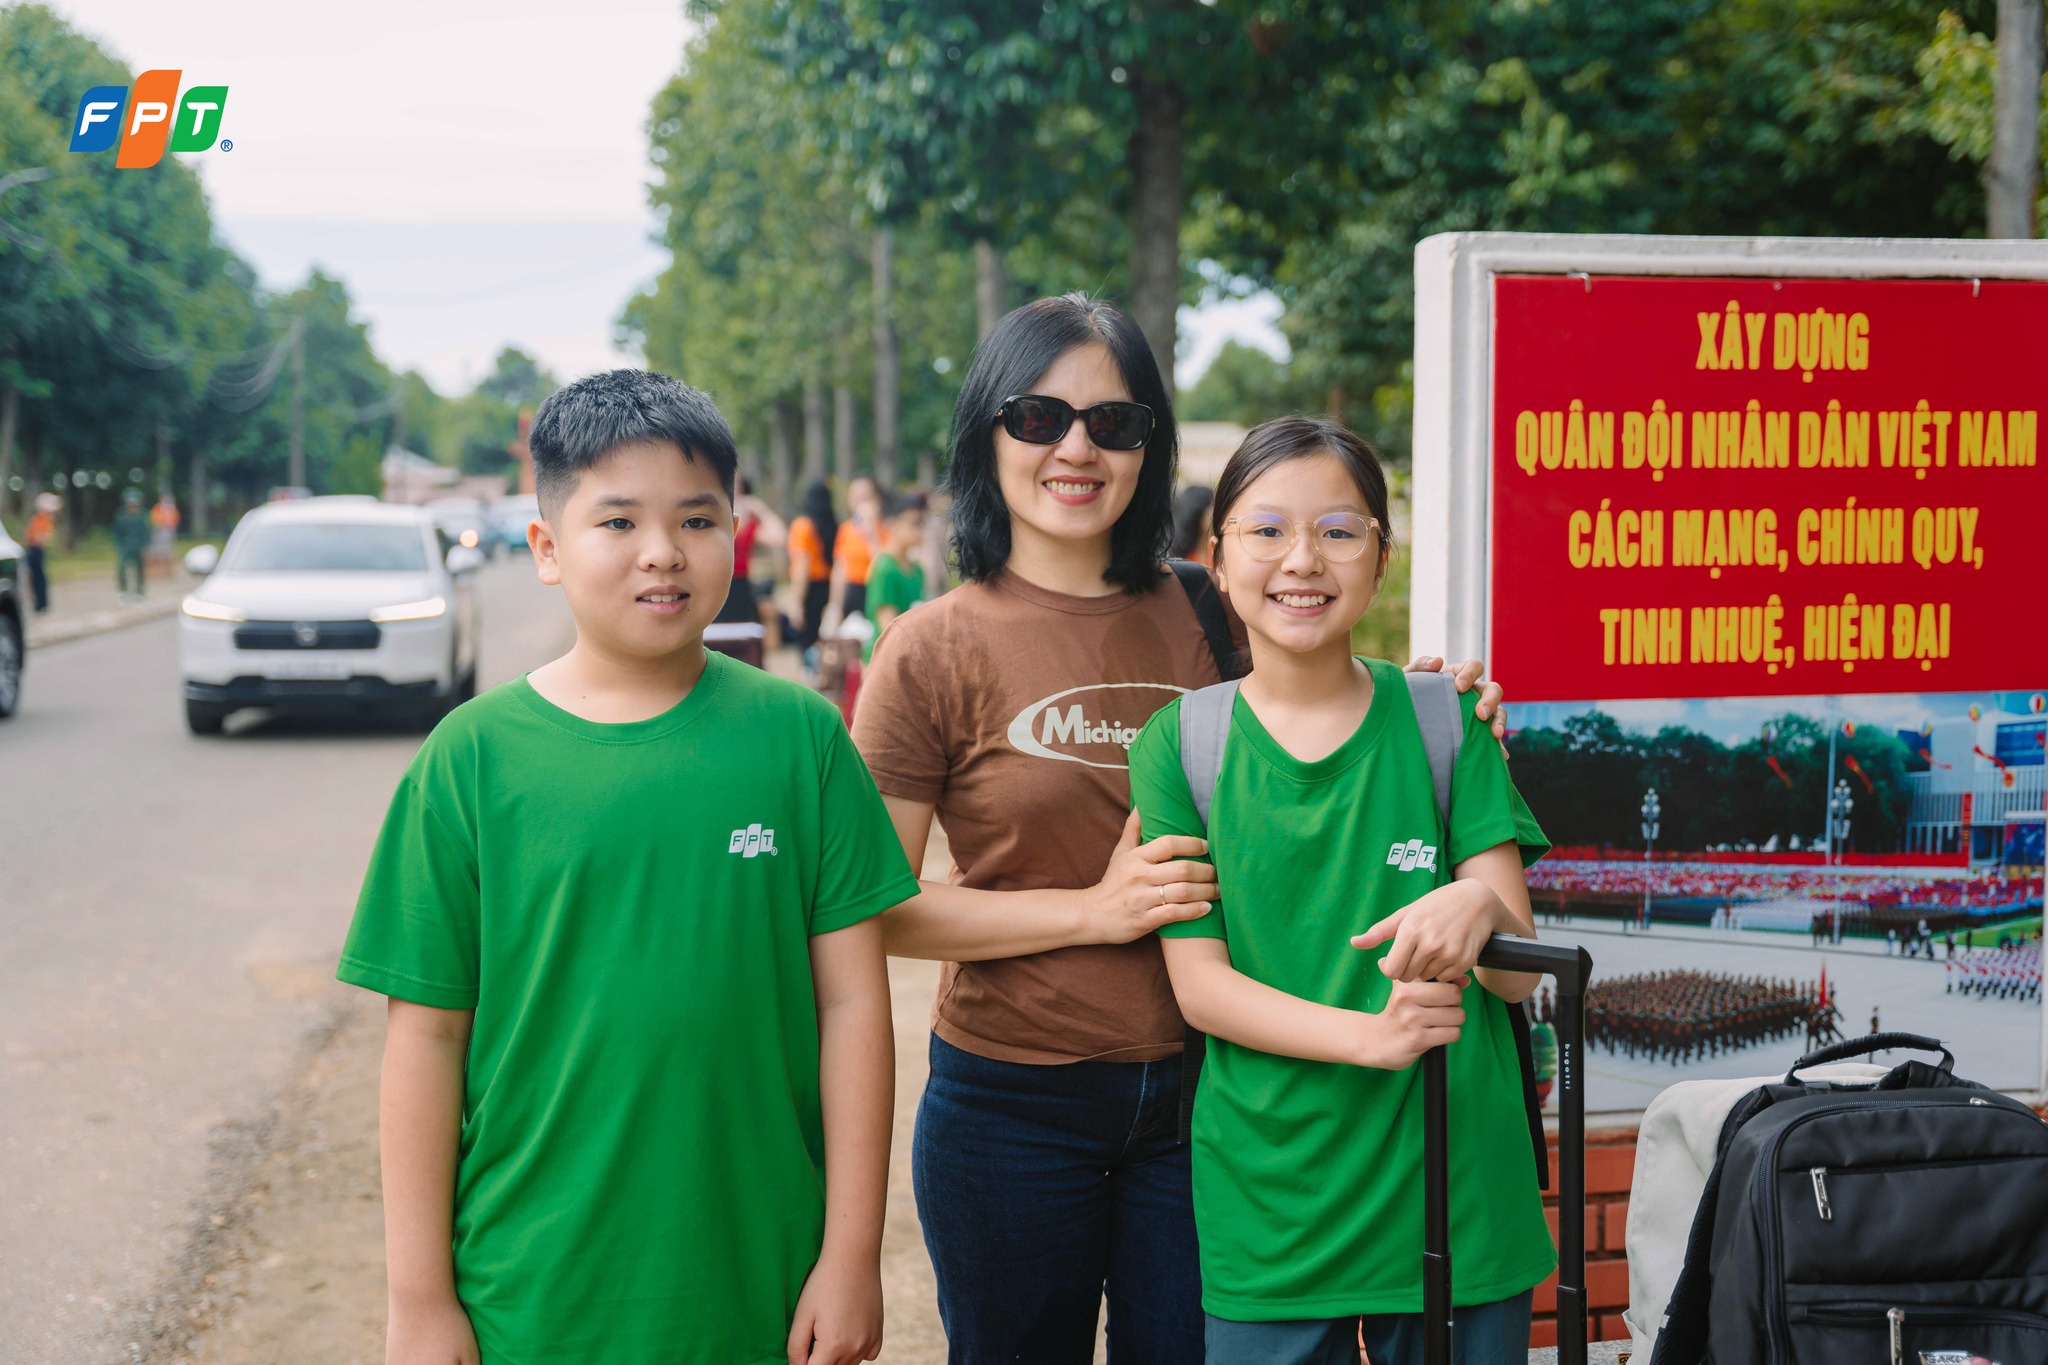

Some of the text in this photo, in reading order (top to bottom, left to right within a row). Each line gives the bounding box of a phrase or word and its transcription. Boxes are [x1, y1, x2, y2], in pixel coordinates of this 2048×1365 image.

[1696, 300, 1870, 383] XÂY DỰNG
[1515, 399, 2038, 482] QUÂN ĐỘI NHÂN DÂN VIỆT NAM
[1568, 496, 1984, 579] CÁCH MẠNG, CHÍNH QUY,
[1600, 593, 1951, 675] TINH NHUỆ, HIỆN ĐẠI
[1041, 704, 1144, 750] Michig
